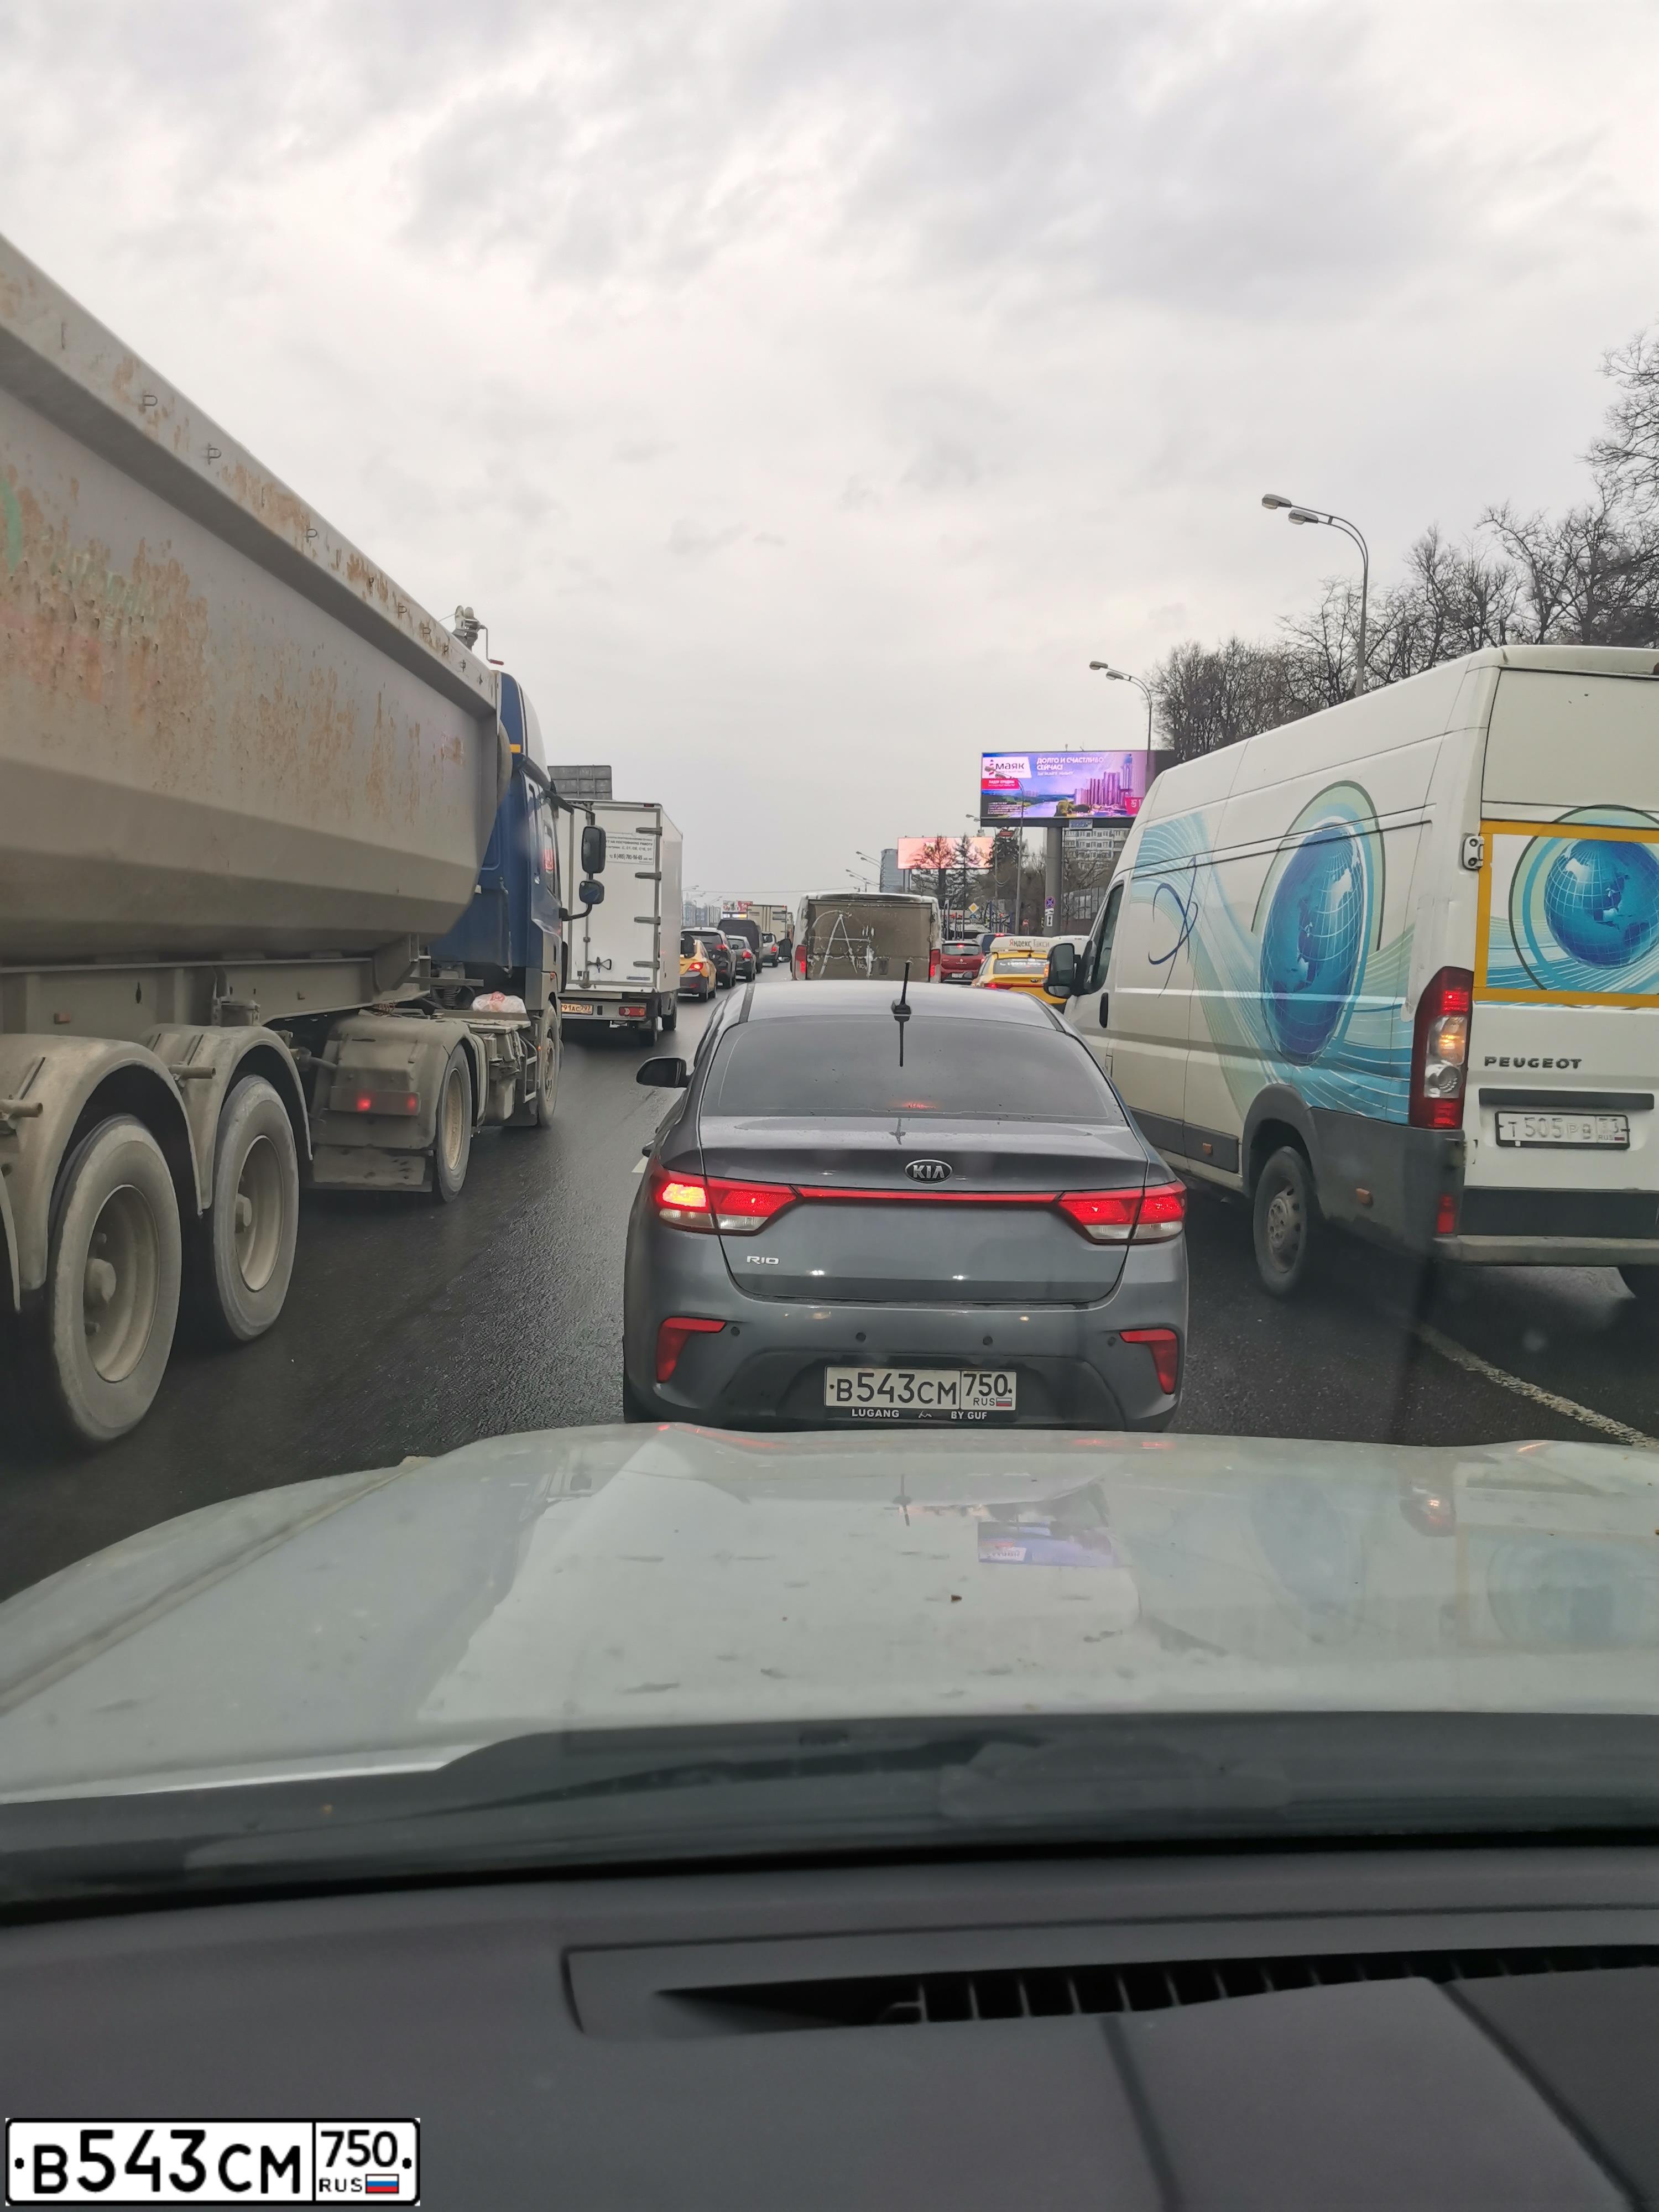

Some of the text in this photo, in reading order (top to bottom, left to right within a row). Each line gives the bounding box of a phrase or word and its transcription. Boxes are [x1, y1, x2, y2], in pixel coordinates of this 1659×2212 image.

[1033, 939, 1050, 947] Такси
[1484, 1056, 1582, 1069] PEUGEOT
[912, 1164, 945, 1179] KIA
[747, 1255, 779, 1265] RIO
[836, 1372, 1008, 1405] B543CM 750
[973, 1398, 995, 1406] RUS
[852, 1408, 987, 1420] LUGANG BY GUF
